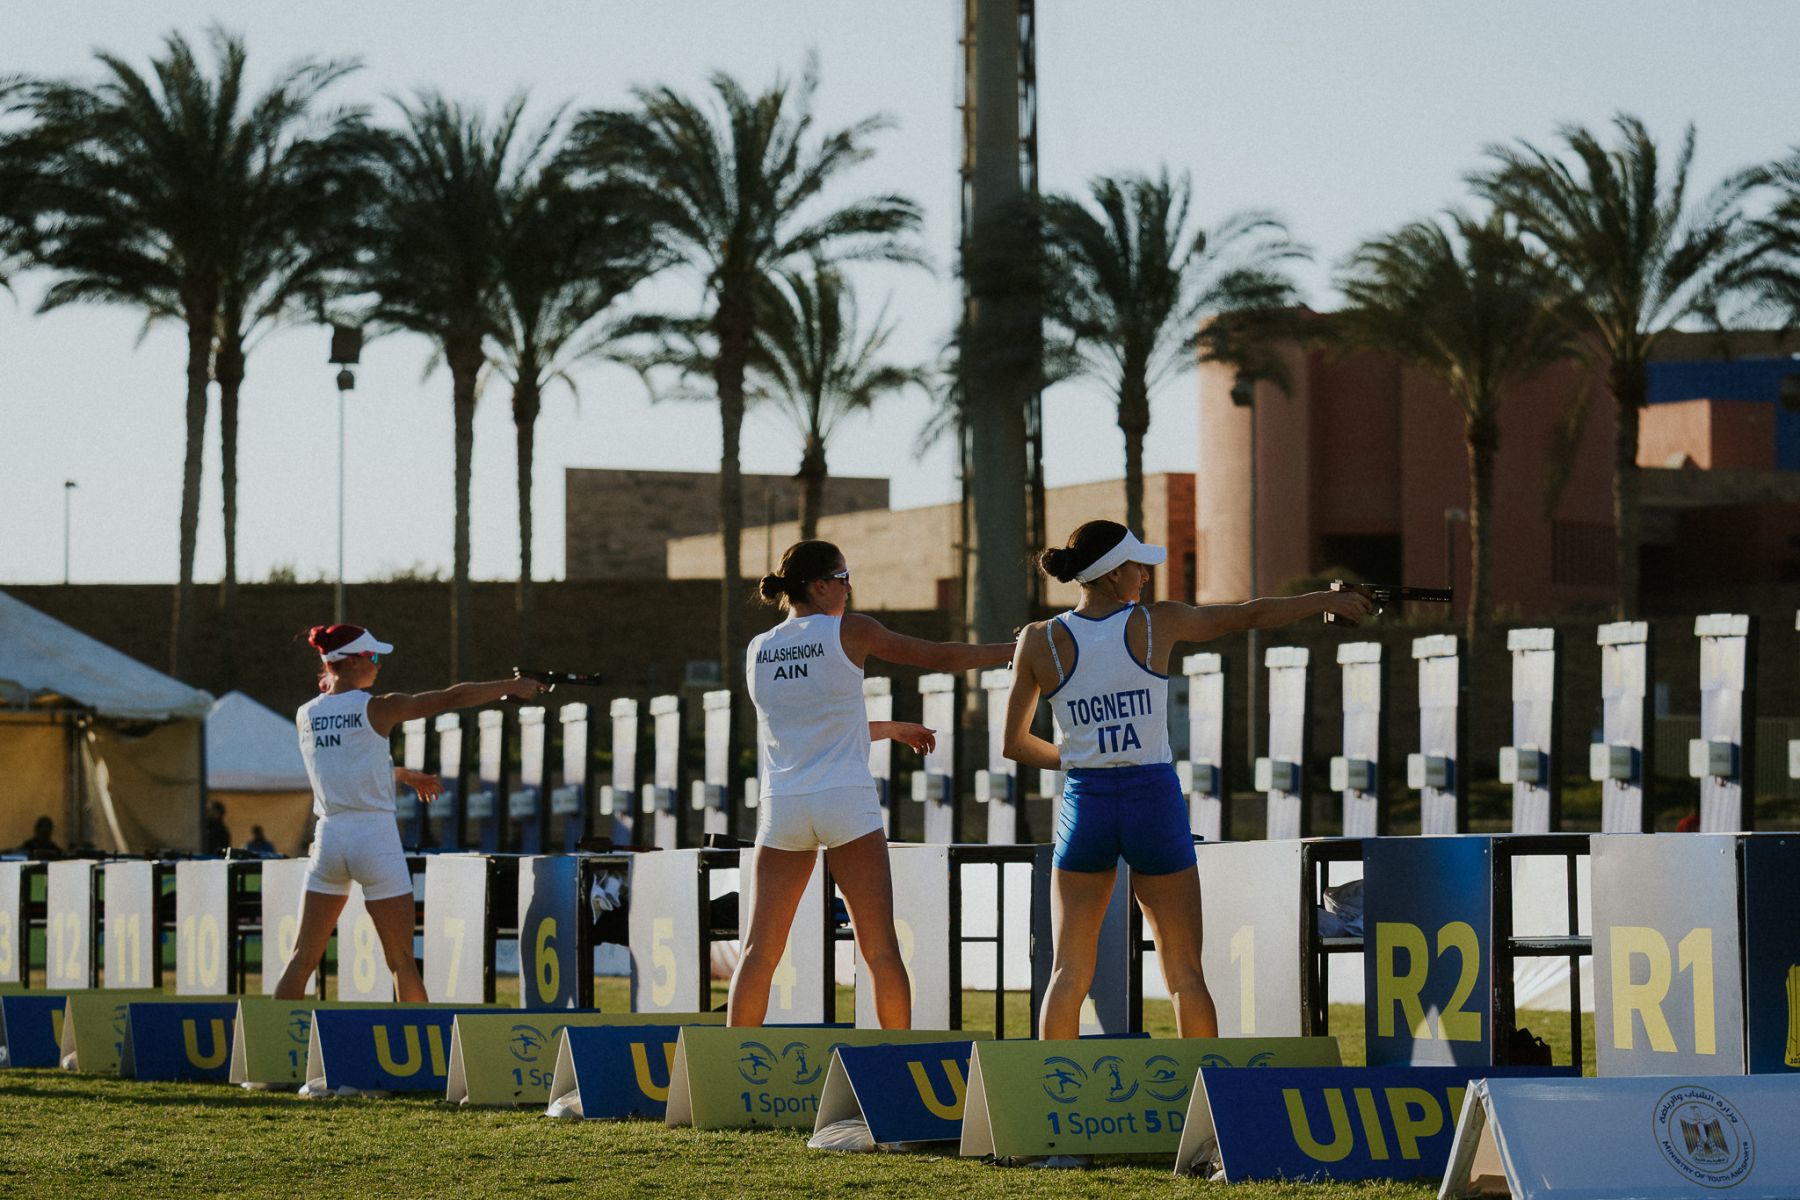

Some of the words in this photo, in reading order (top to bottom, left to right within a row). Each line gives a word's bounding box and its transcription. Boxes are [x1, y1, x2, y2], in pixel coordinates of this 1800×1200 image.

[756, 642, 825, 664] MALASHENOKA
[773, 663, 808, 681] AIN
[315, 734, 341, 748] AIN
[1066, 688, 1152, 726] TOGNETTI
[1097, 723, 1142, 754] ITA
[54, 912, 81, 980] 12
[114, 913, 140, 983] 11
[184, 914, 220, 988] 10
[353, 913, 376, 994] 8
[443, 917, 466, 998] 7
[535, 917, 560, 1004] 6
[652, 917, 676, 1007] 5
[1230, 925, 1256, 1034] 1
[1376, 921, 1482, 1042] R2
[1610, 926, 1717, 1055] R1
[512, 1069, 523, 1086] 1
[741, 1092, 753, 1112] 1
[759, 1092, 818, 1117] Sport
[1047, 1112, 1061, 1135] 1
[1070, 1111, 1138, 1140] Sport
[1144, 1110, 1162, 1133] 5
[1662, 1140, 1694, 1174] MINISTRY
[1694, 1170, 1705, 1179] OF
[1708, 1175, 1731, 1183] YOUTH
